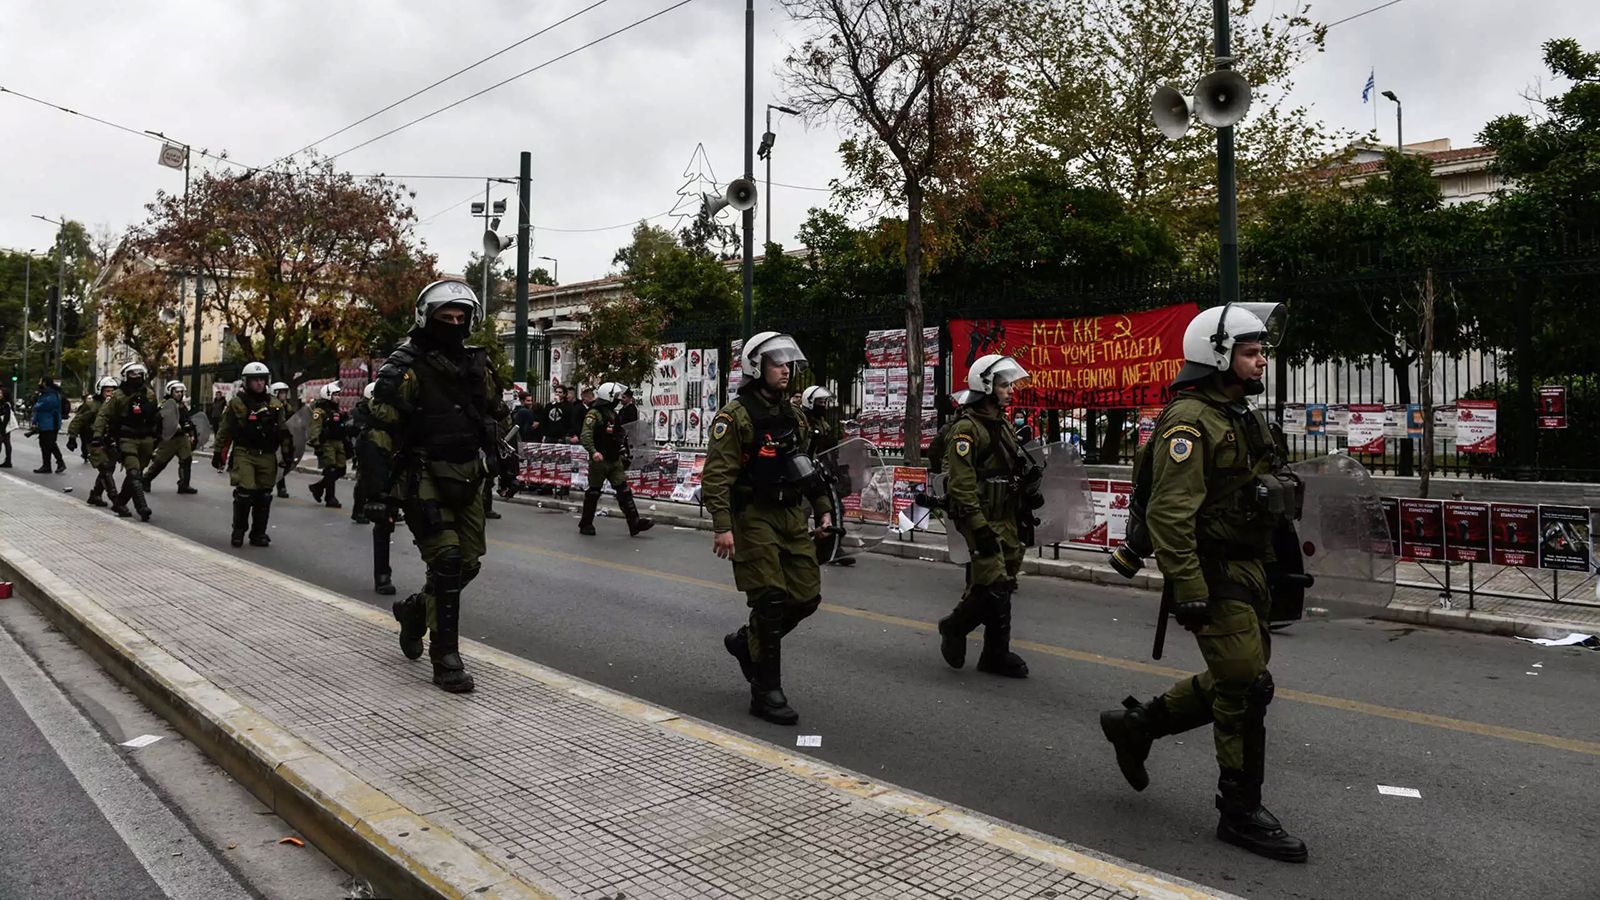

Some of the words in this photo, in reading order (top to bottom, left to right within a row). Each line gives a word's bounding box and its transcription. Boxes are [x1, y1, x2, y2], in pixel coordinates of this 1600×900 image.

[1032, 321, 1066, 346] Μ-Λ
[1073, 317, 1104, 343] ΚΚΕ
[1030, 346, 1051, 366] ΓΙΑ
[1060, 336, 1162, 365] ΨΩΜΙ-ΠΑΙΔΕΙΑ
[1121, 358, 1185, 387] ΑΝΕΞΑΡΤΗΣ
